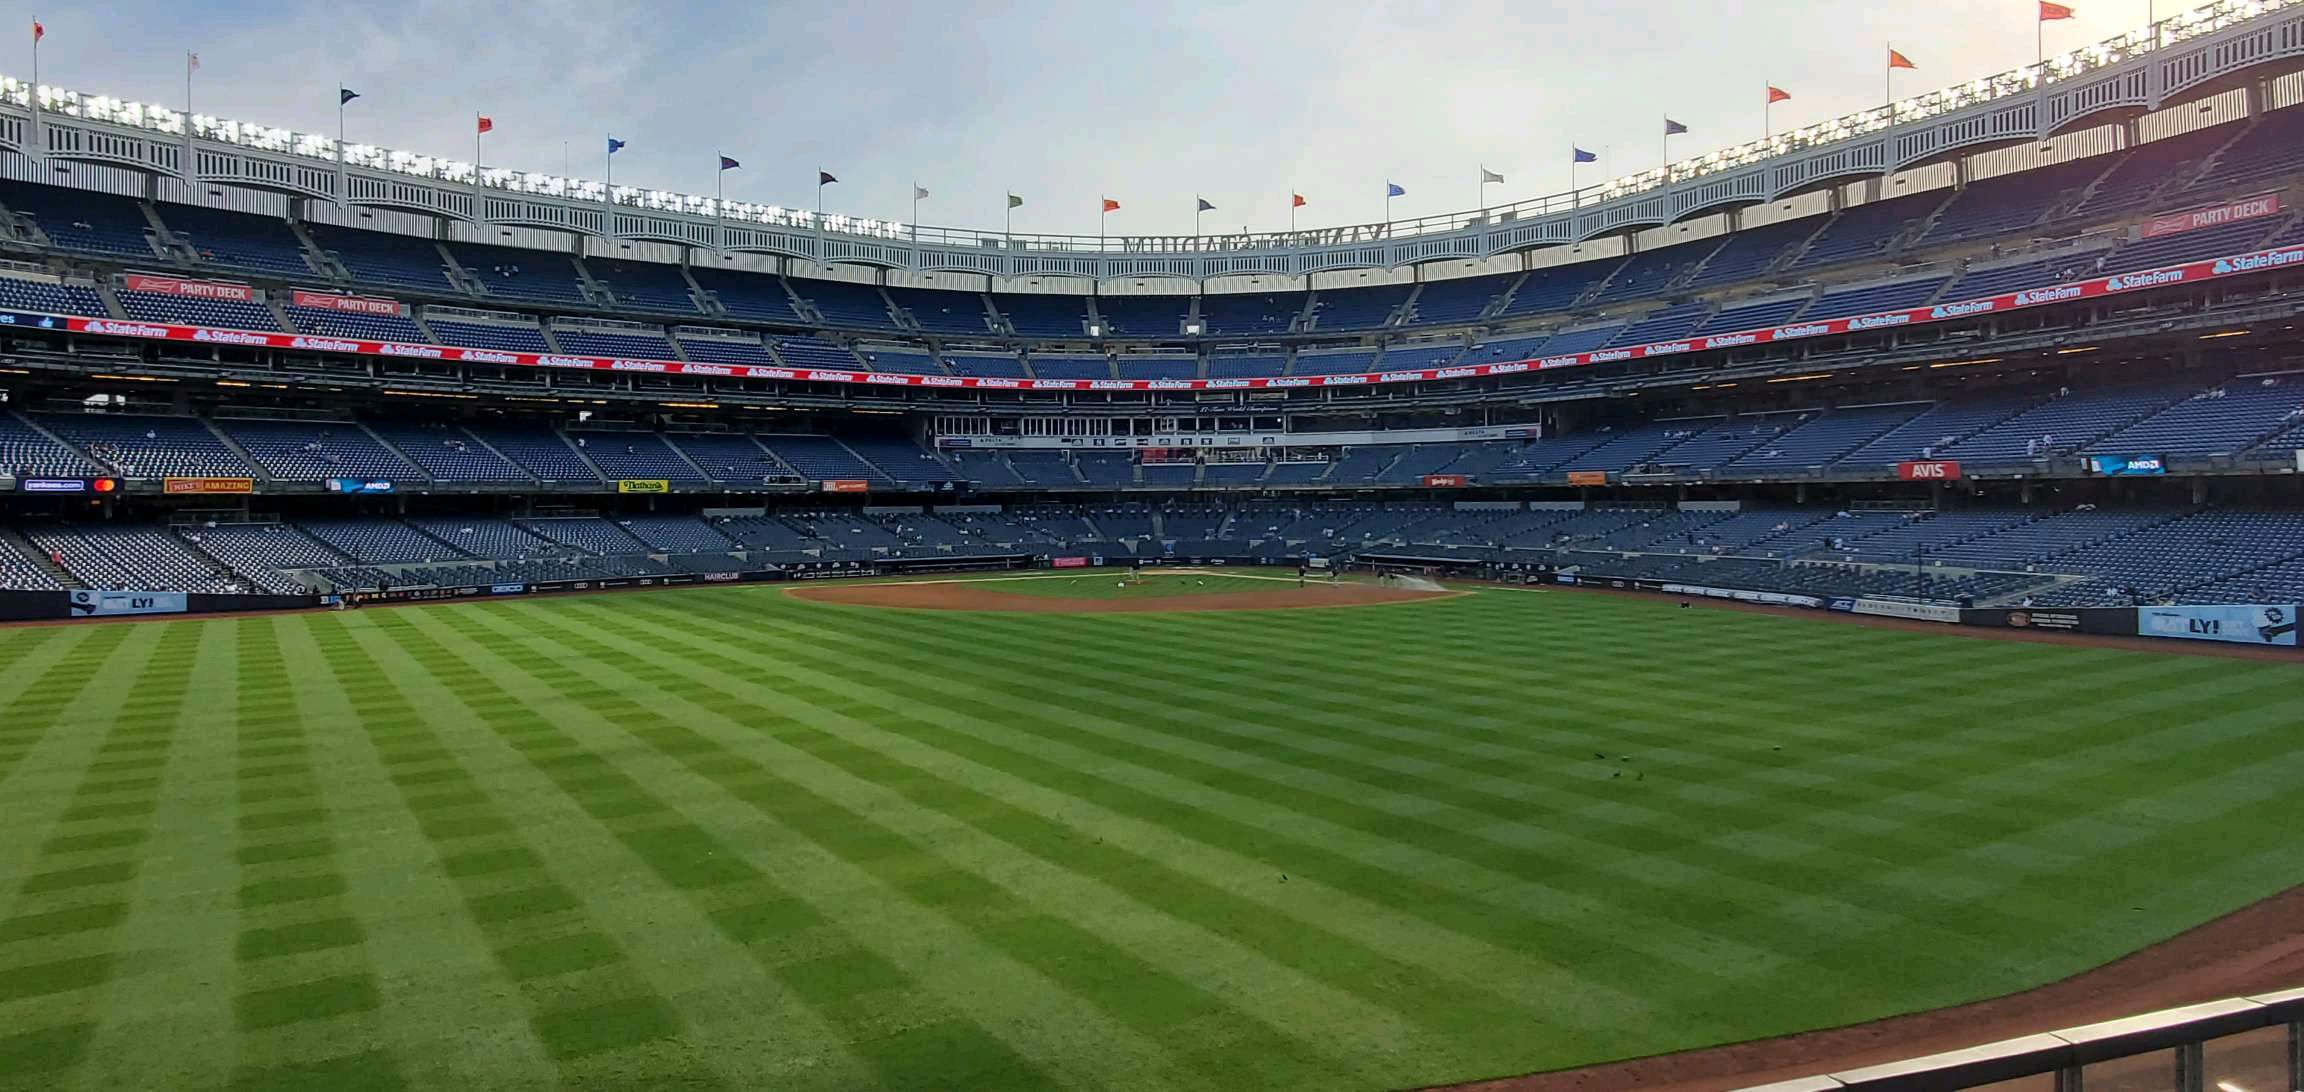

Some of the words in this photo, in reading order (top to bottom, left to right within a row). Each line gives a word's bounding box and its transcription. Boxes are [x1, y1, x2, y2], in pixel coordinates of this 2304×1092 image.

[2192, 207, 2230, 226] PARTY
[2233, 200, 2269, 219] DECK
[180, 282, 214, 297] PARTY
[217, 286, 245, 299] DECK
[337, 299, 366, 312] PARTY
[369, 302, 393, 314] DECK
[1912, 464, 1945, 477] AVIS
[2128, 461, 2152, 469] AMD
[204, 481, 250, 489] AMAZING
[491, 585, 523, 593] GEICO
